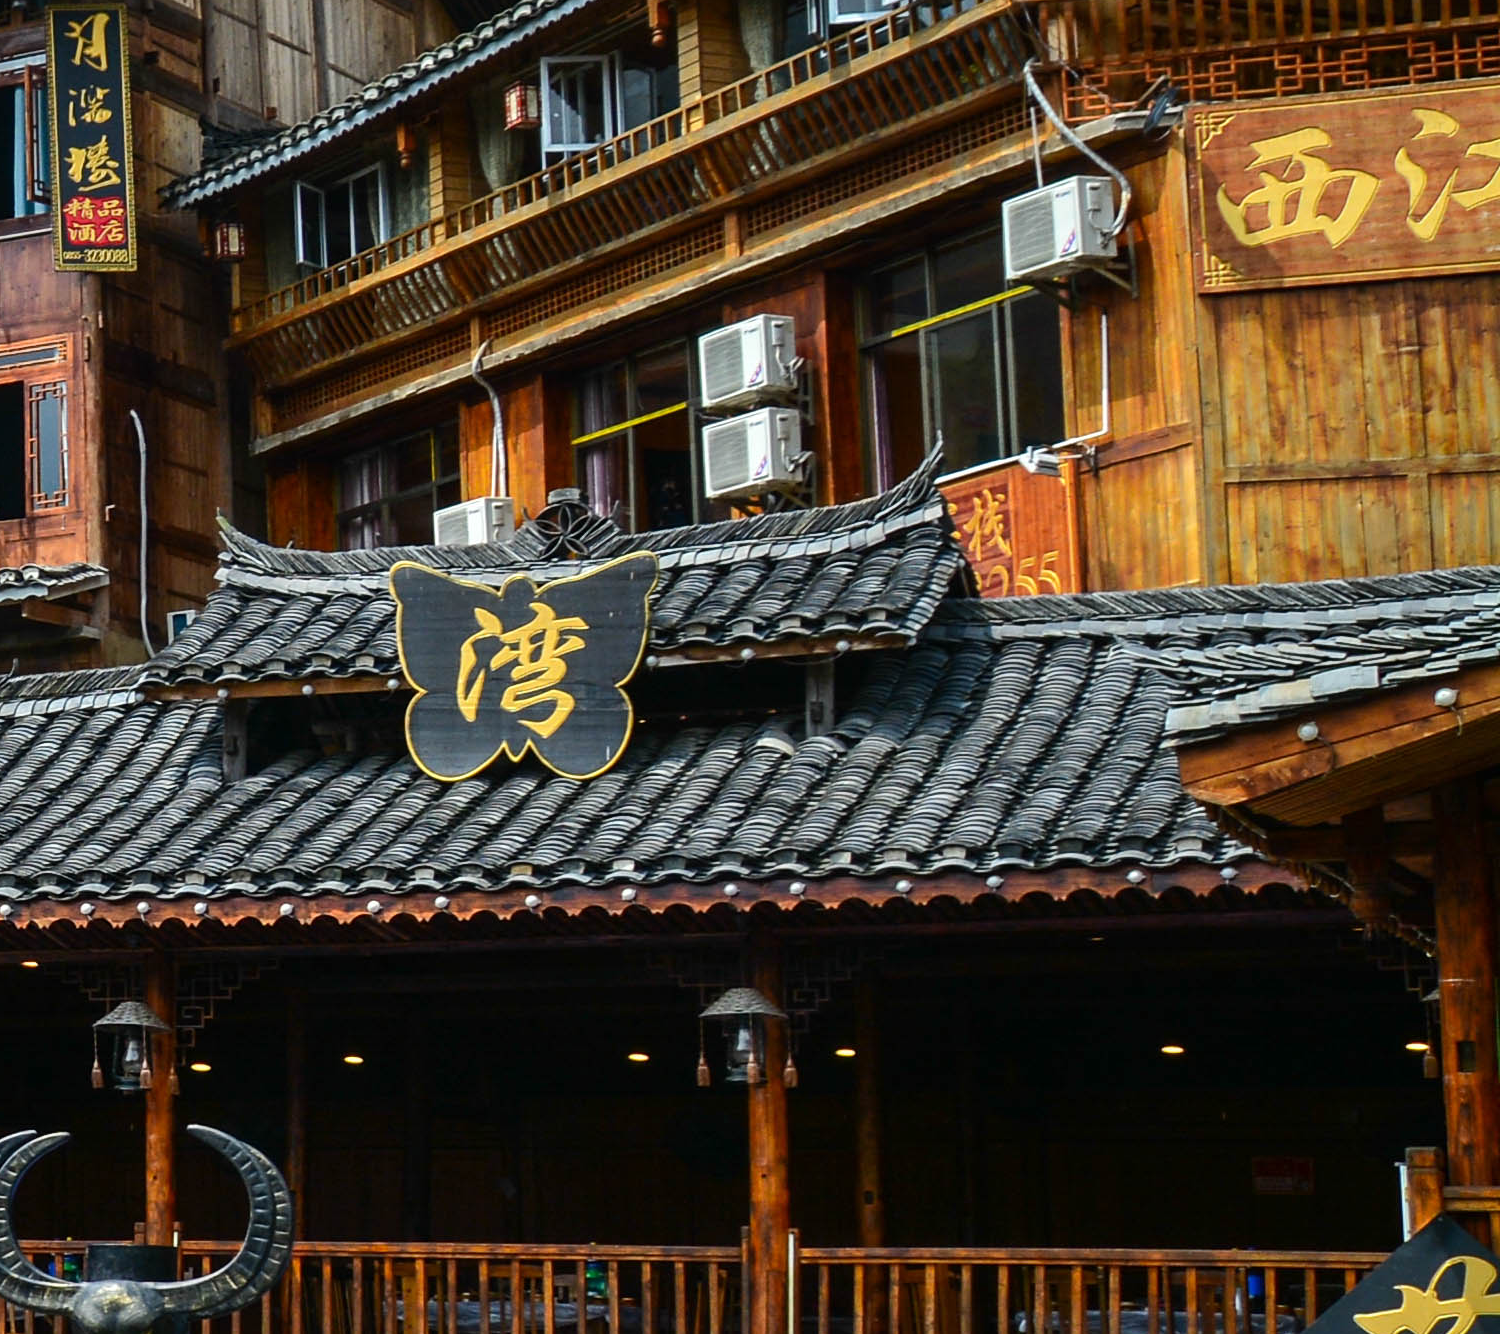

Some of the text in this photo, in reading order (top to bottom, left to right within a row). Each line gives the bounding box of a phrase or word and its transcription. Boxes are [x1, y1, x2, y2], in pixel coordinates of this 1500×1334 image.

[64, 198, 124, 219] 精品
[67, 221, 125, 244] 酒店
[456, 602, 589, 738] 湾
